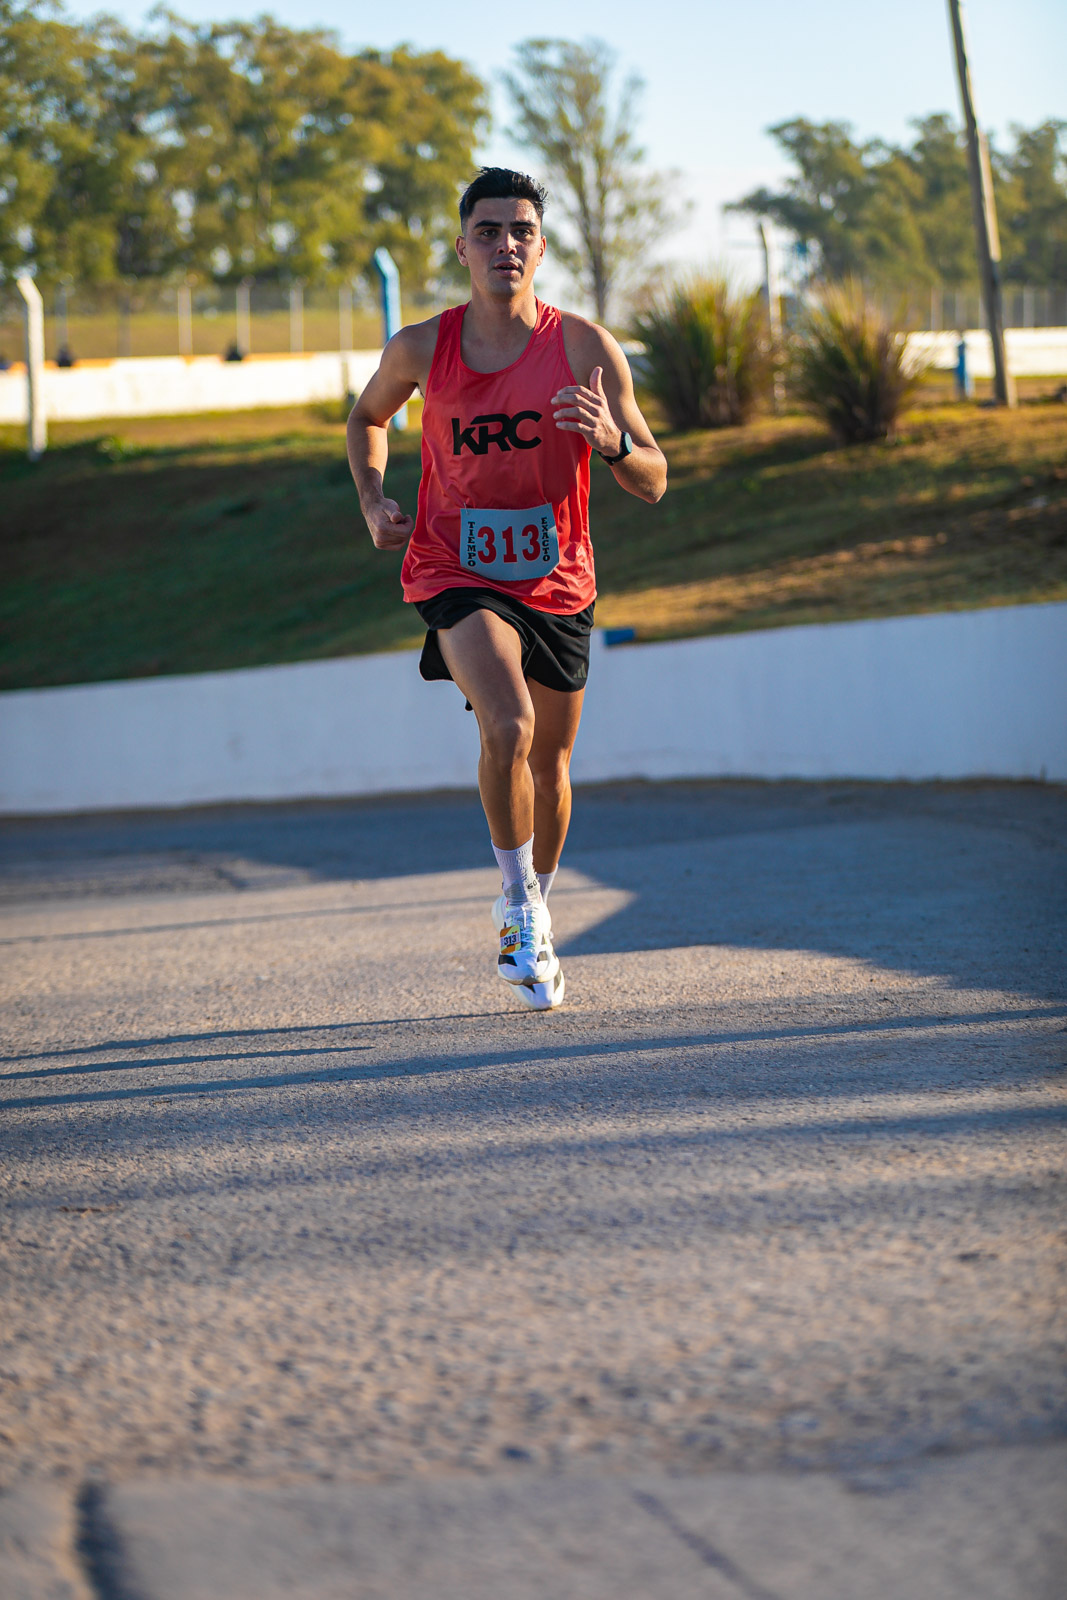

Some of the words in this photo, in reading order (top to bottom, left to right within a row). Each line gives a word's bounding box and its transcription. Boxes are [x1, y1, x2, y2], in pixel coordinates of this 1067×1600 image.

[467, 521, 476, 567] TIEMPO
[477, 524, 541, 563] 313
[541, 517, 550, 562] EXACTO
[503, 934, 517, 946] 313
